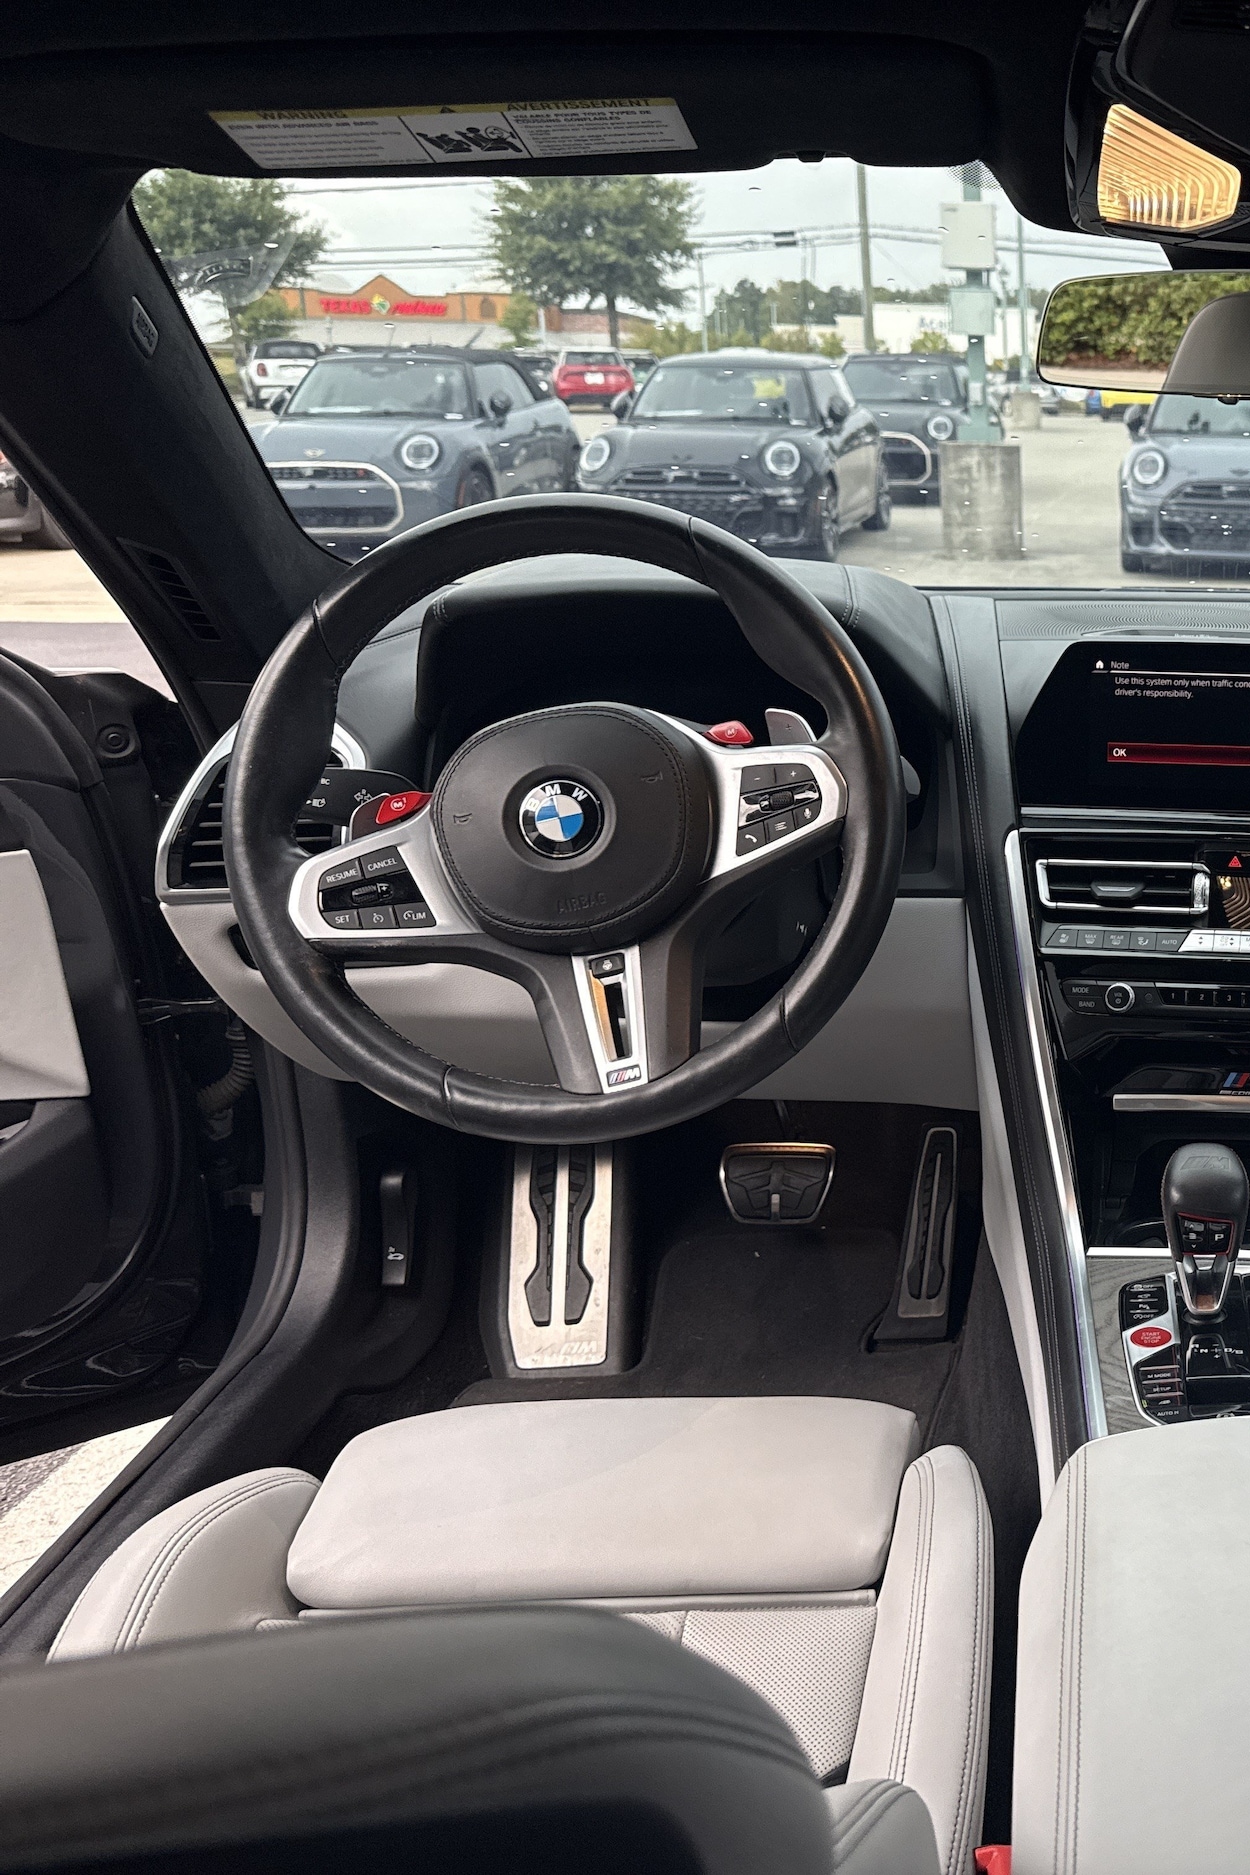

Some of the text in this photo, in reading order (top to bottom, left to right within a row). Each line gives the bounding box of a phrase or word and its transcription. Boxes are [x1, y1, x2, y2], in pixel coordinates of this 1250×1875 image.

[507, 99, 652, 112] AVERTISSEMENT
[256, 110, 349, 120] WARNING
[319, 298, 372, 315] TEXAS
[1110, 661, 1130, 669] Note
[1114, 676, 1130, 685] Use
[1131, 677, 1145, 685] this
[1146, 678, 1173, 687] system
[1173, 679, 1190, 688] only
[1191, 679, 1210, 687] when
[1211, 679, 1233, 688] traffic
[1114, 688, 1194, 699] driver's responsibility.
[1112, 748, 1127, 758] OK
[525, 783, 589, 812] BMW
[367, 858, 398, 871] CANCEL
[325, 868, 358, 883] RESUME
[334, 915, 350, 924] SET
[412, 912, 426, 920] LIM
[1071, 986, 1089, 994] MODE
[1199, 993, 1205, 1001] 2
[1078, 1000, 1095, 1008] BAND
[1214, 1233, 1225, 1241] P
